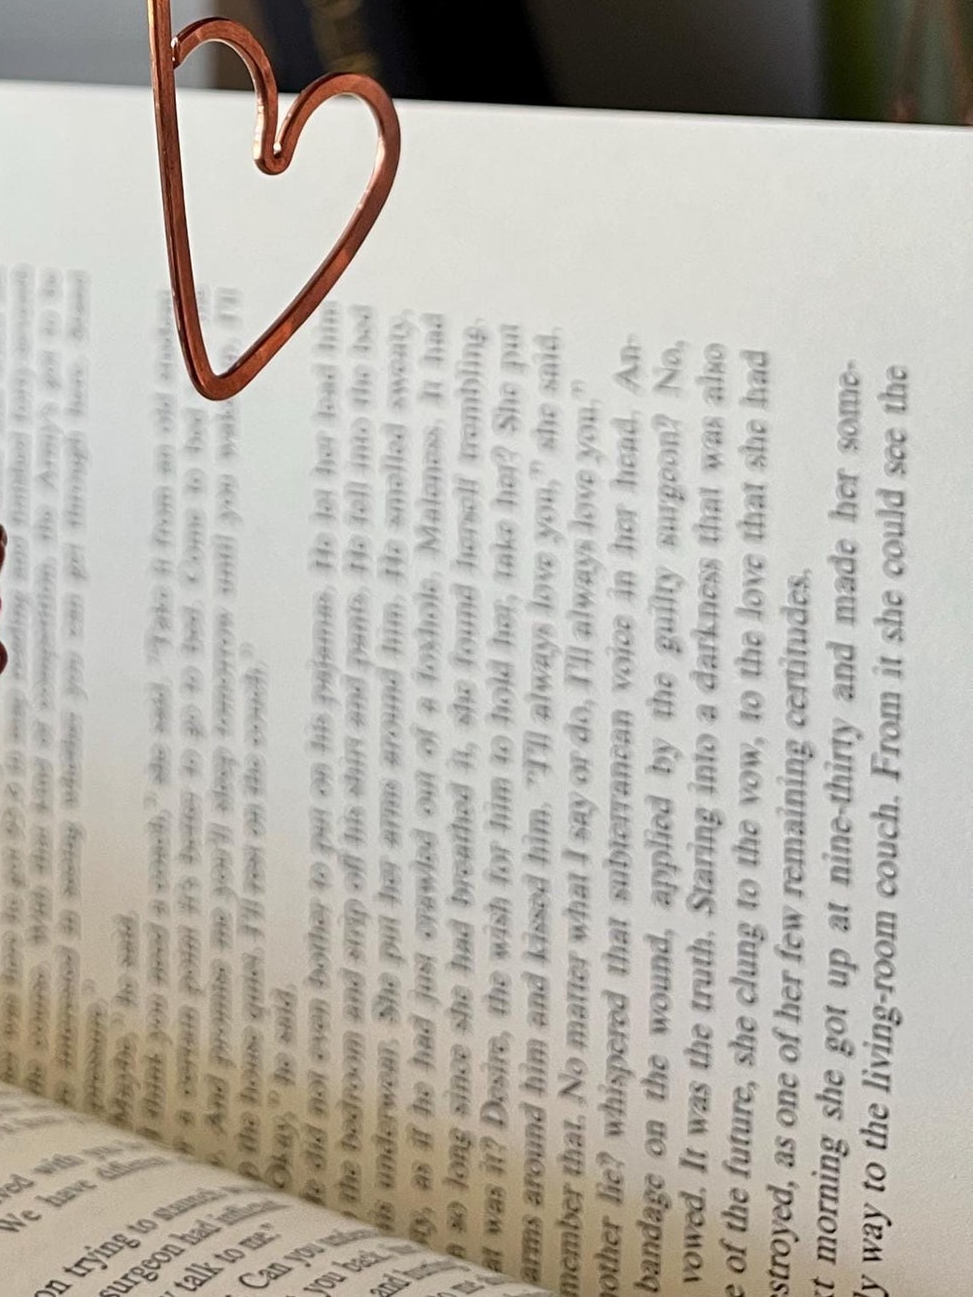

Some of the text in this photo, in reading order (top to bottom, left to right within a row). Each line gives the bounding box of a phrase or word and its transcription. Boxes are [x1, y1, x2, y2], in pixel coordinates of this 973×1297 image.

[834, 358, 863, 455] some-
[875, 364, 911, 416] the
[649, 412, 687, 548] surgeon?
[882, 427, 909, 479] see
[826, 466, 861, 524] her
[607, 507, 639, 558] her
[873, 487, 908, 579] could
[604, 569, 637, 603] in
[647, 566, 687, 657] guilty
[826, 538, 859, 628] made
[871, 589, 906, 645] she
[604, 614, 637, 693] voice
[824, 640, 858, 703] and
[871, 654, 905, 680] it
[643, 672, 676, 720] the
[644, 737, 681, 777] by
[869, 690, 906, 784] From
[677, 341, 727, 1285] vowed. It was the truth. Staring into a darkness that was also
[716, 348, 772, 1276] of the future, she clung to the vow, to the love that she had
[820, 717, 865, 888] nine-thirty
[642, 793, 682, 909] applied
[868, 794, 902, 900] couch.
[764, 567, 815, 1297] stroyed, as one of her few remaining certitudes.
[824, 900, 852, 934] at
[603, 915, 631, 978] that
[826, 947, 860, 989] up
[643, 928, 675, 1036] wound,
[859, 909, 904, 1095] living-room
[821, 1003, 857, 1059] got
[597, 988, 635, 1138] whispered
[639, 1053, 670, 1103] the
[813, 1068, 846, 1122] she
[644, 1118, 668, 1159] on
[857, 1101, 891, 1152] the
[33, 1154, 85, 1175] with
[36, 1179, 97, 1207] have
[595, 1150, 625, 1207] lie?
[859, 1160, 888, 1194] to
[809, 1134, 851, 1266] morning
[64, 1218, 158, 1277] trying to
[100, 1214, 221, 1297] surgeon had
[632, 1172, 673, 1295] bandage
[859, 1201, 894, 1264] way
[175, 1261, 225, 1292] talk
[214, 1247, 246, 1263] to
[239, 1242, 326, 1289] Can you
[304, 1270, 347, 1297] you
